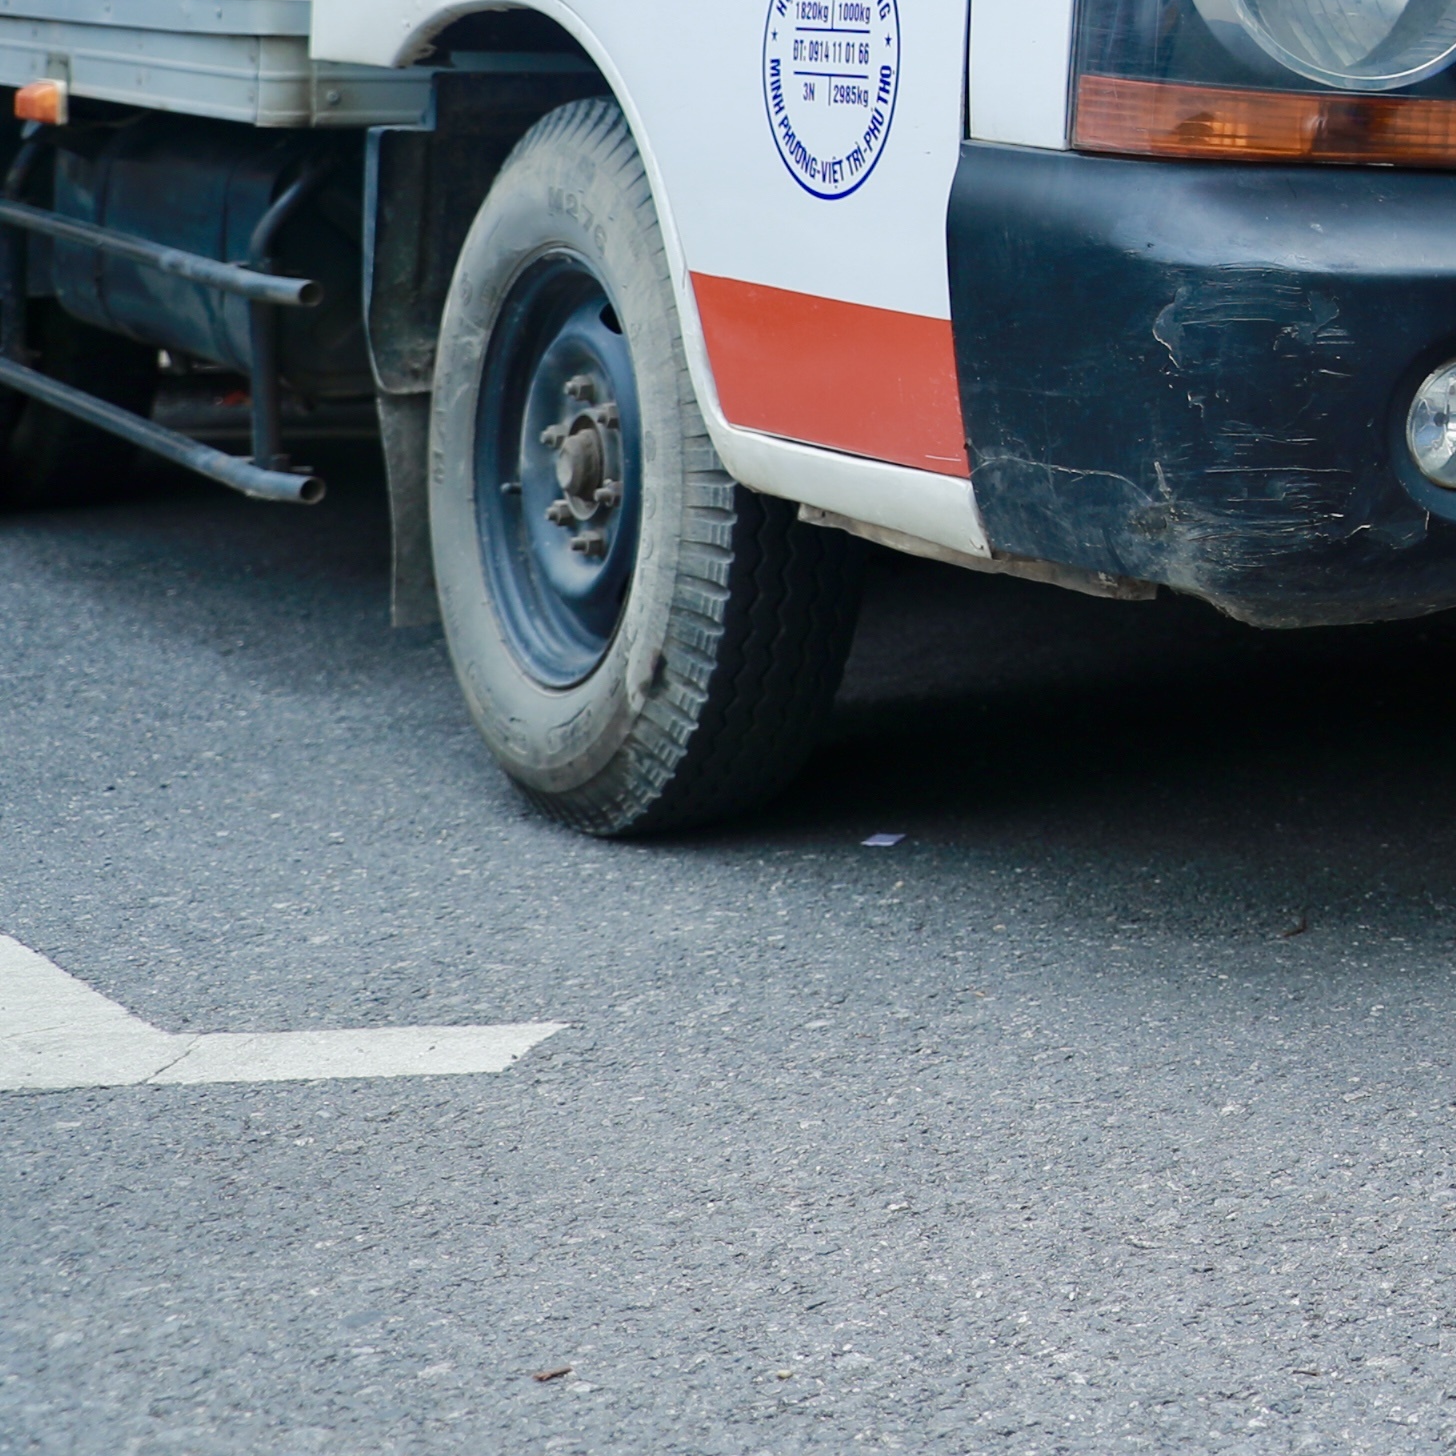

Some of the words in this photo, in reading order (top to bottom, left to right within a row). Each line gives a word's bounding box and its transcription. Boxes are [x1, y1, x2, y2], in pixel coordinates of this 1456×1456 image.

[796, 1, 829, 23] 1820kg
[838, 2, 871, 24] 1000kg
[809, 40, 829, 63] 0914
[832, 41, 842, 63] 11
[845, 42, 855, 64] 01
[858, 42, 869, 65] 66
[770, 58, 785, 115] MINH
[802, 82, 815, 101] 3N
[833, 84, 869, 108] 2985kg
